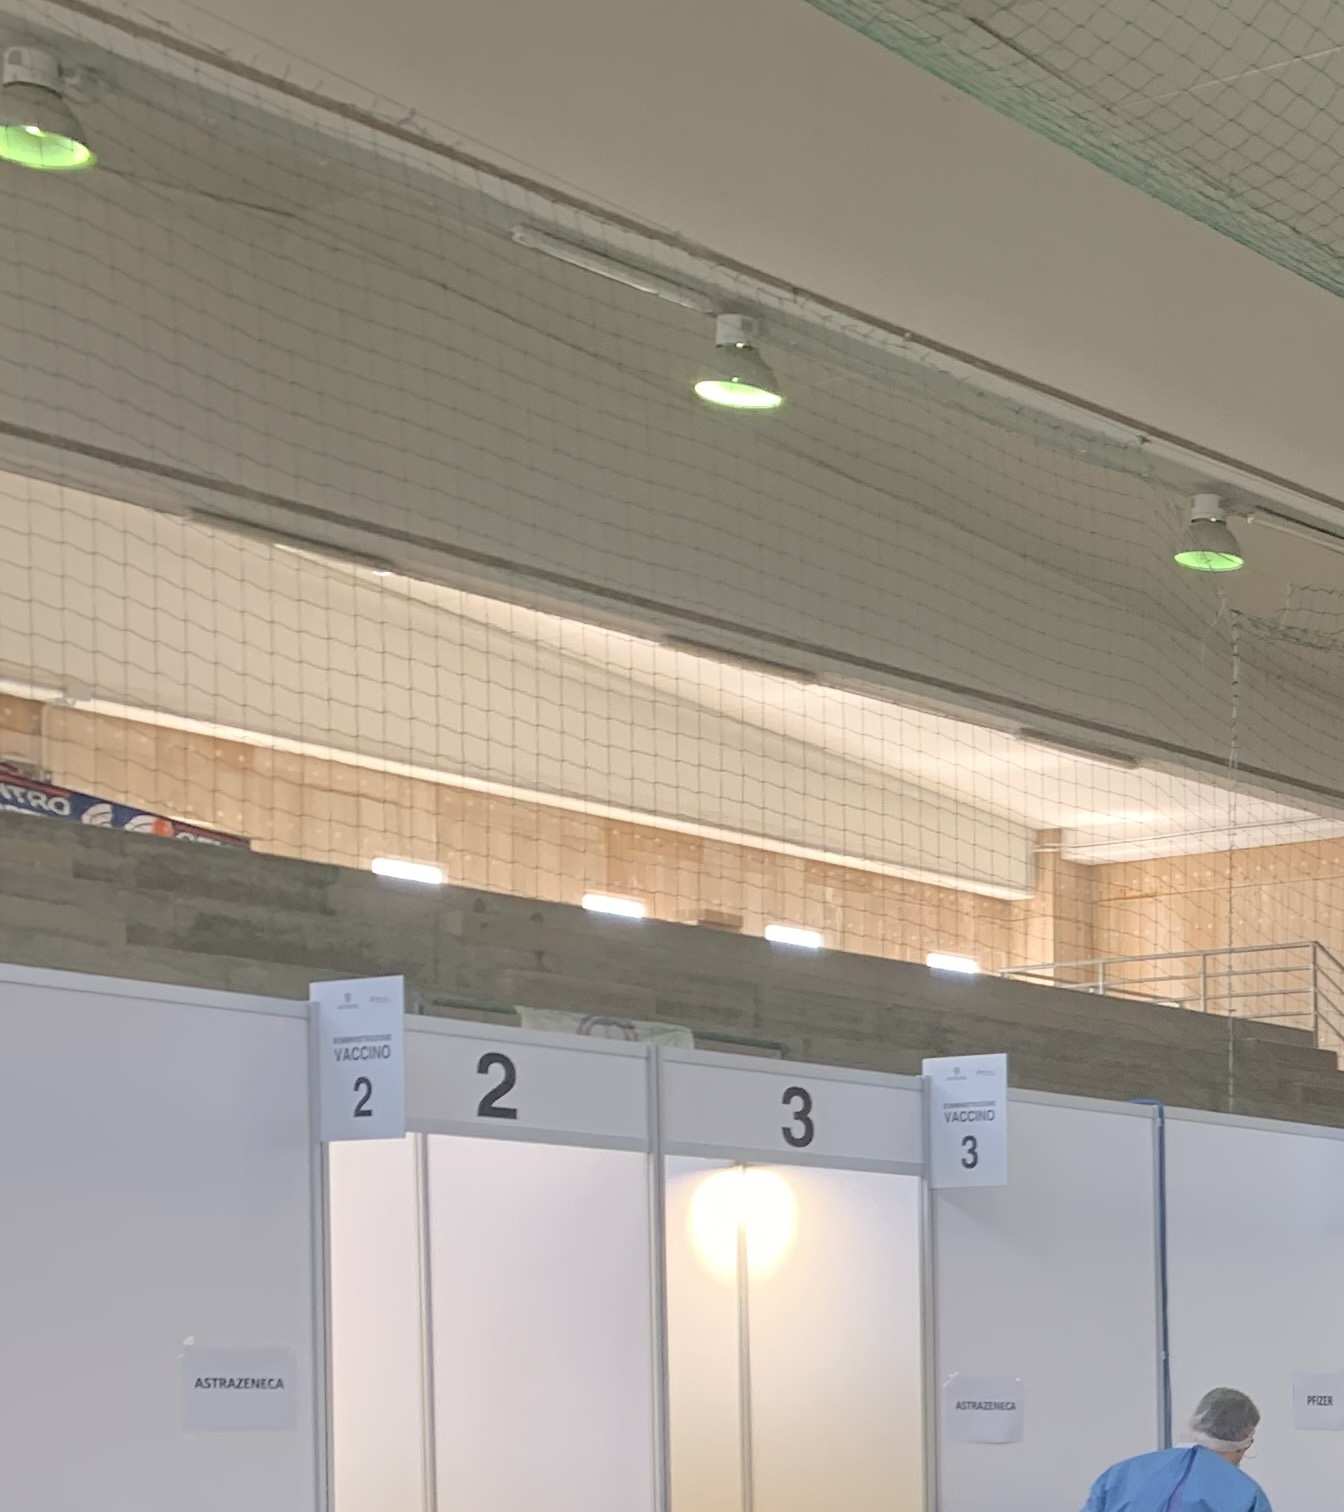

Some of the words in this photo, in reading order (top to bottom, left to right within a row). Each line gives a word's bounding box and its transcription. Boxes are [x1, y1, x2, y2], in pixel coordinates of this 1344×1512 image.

[0, 783, 71, 816] TRO
[334, 1045, 391, 1062] VACCINO
[353, 1076, 373, 1118] 2
[477, 1052, 518, 1120] 2
[781, 1086, 815, 1148] 3
[943, 1109, 996, 1124] VACCINO
[961, 1135, 979, 1169] 3
[194, 1377, 285, 1390] ASTRAZENECA
[955, 1401, 1017, 1411] ASTRAZENECA
